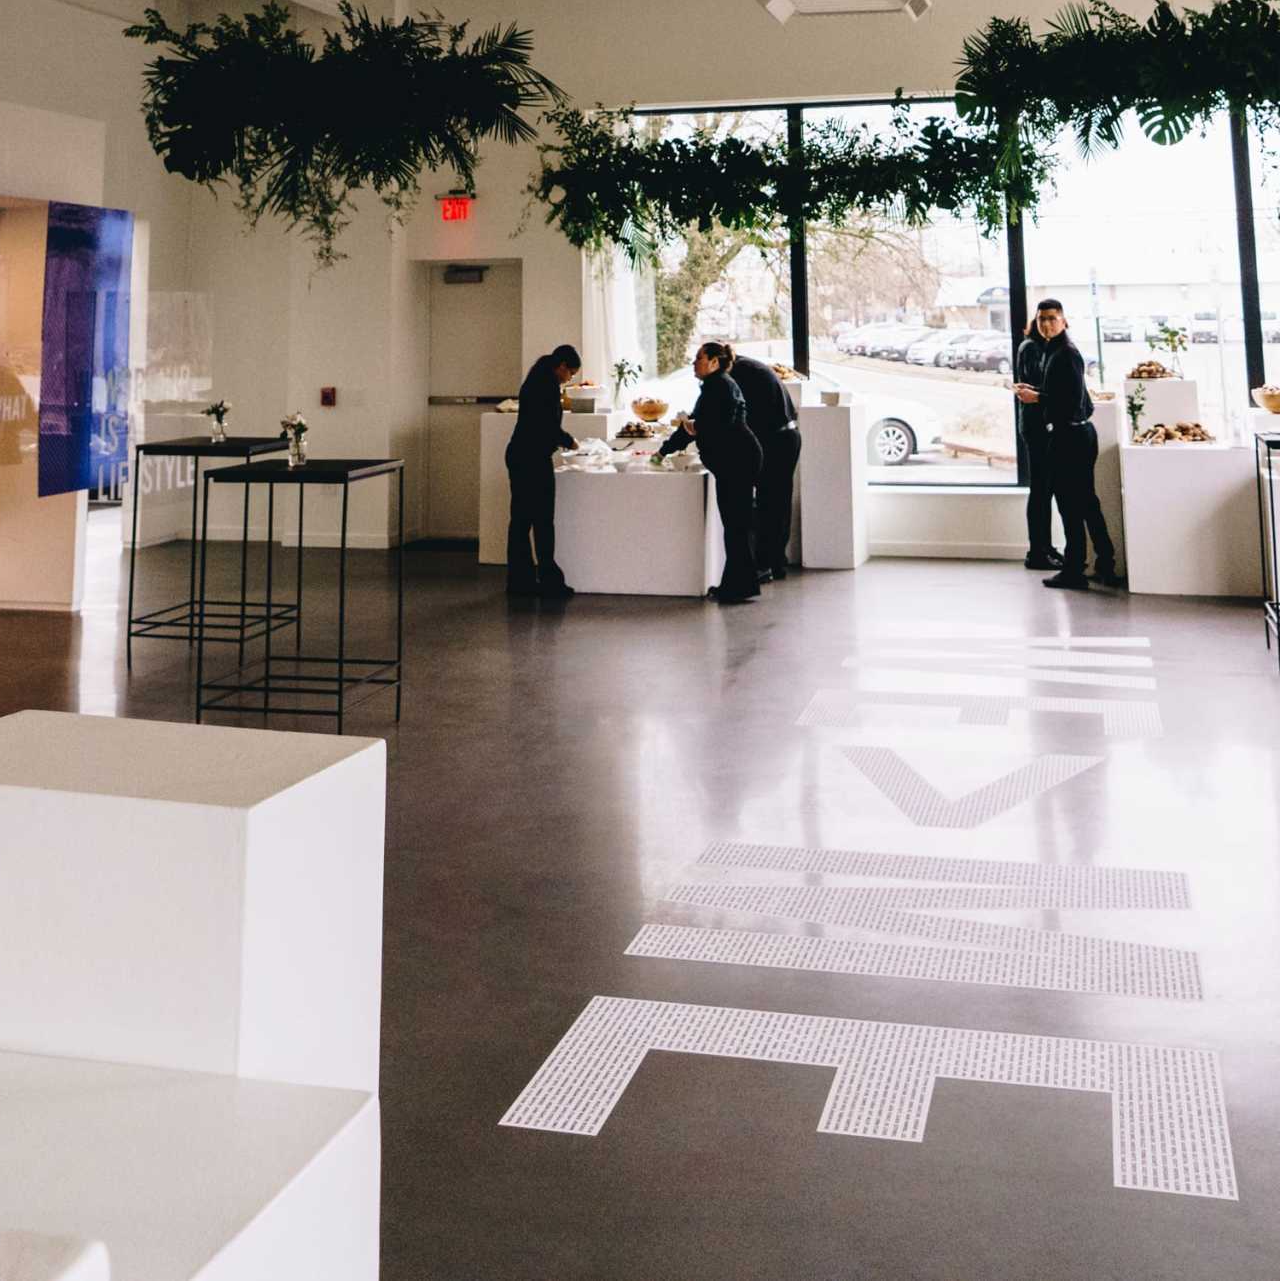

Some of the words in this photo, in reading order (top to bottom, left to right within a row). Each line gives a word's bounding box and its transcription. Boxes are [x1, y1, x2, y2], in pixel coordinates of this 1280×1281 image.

[441, 199, 470, 222] EXIT
[99, 411, 119, 454] IS
[97, 455, 195, 502] LIFSTYLE
